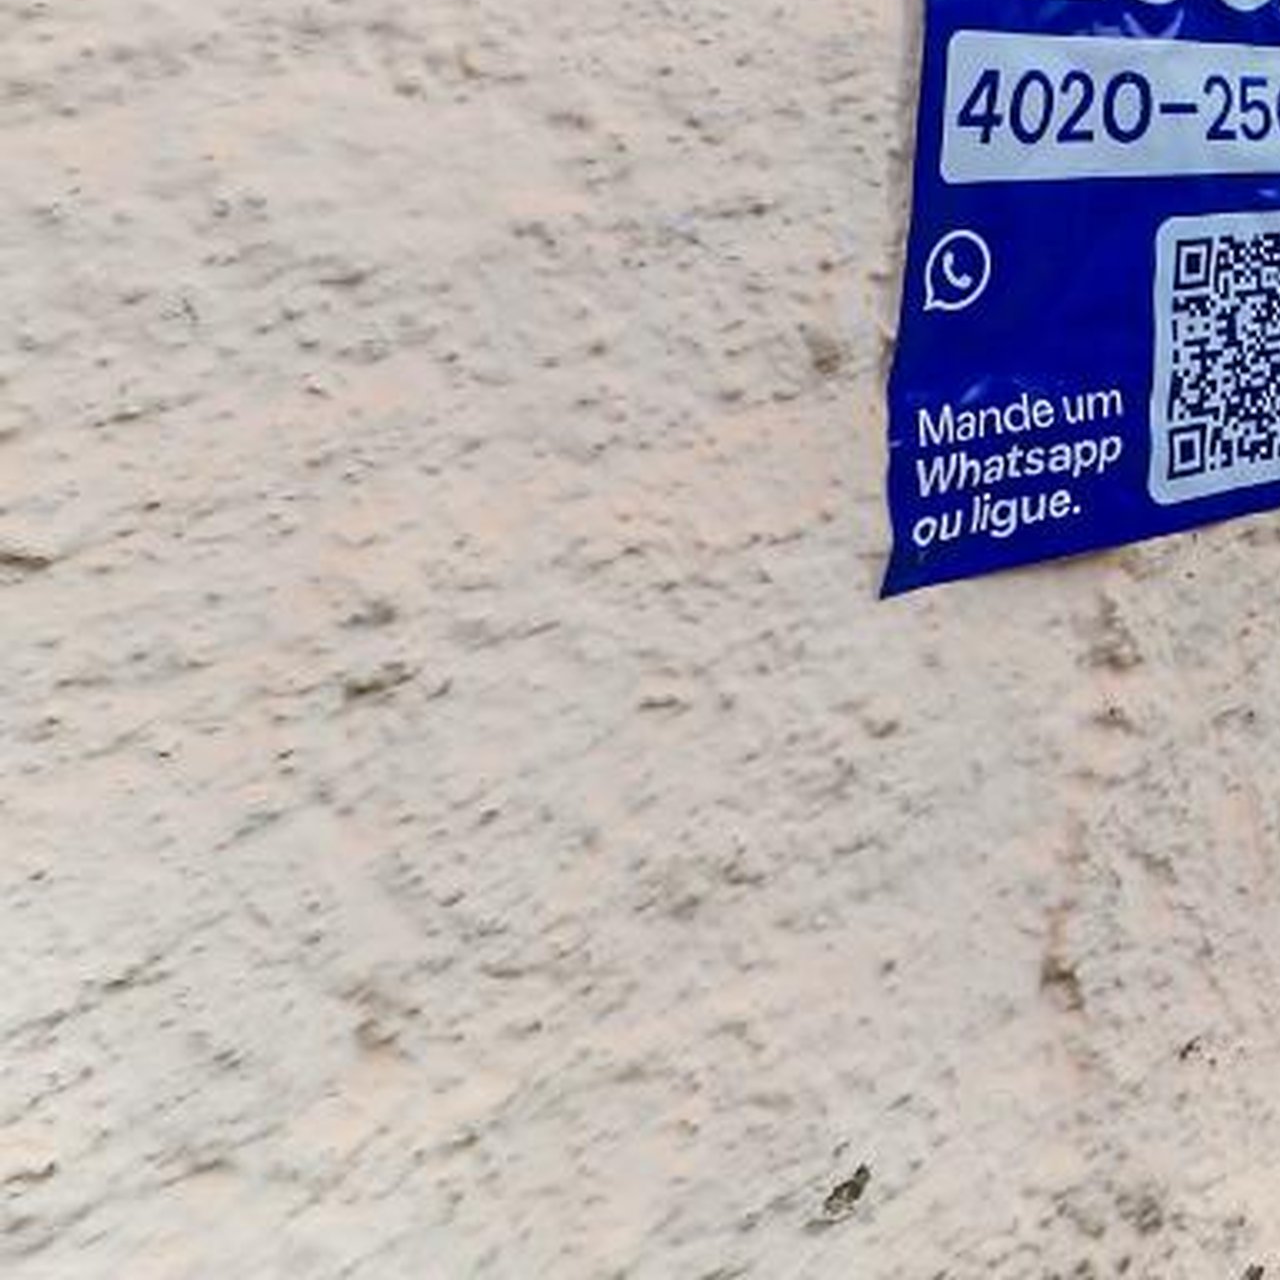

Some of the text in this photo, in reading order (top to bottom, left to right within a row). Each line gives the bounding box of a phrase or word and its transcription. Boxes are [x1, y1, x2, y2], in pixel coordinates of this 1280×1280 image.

[917, 389, 1123, 448] Mande um
[915, 435, 1123, 498] Whatsapp
[911, 488, 1081, 548] ou ligue.
